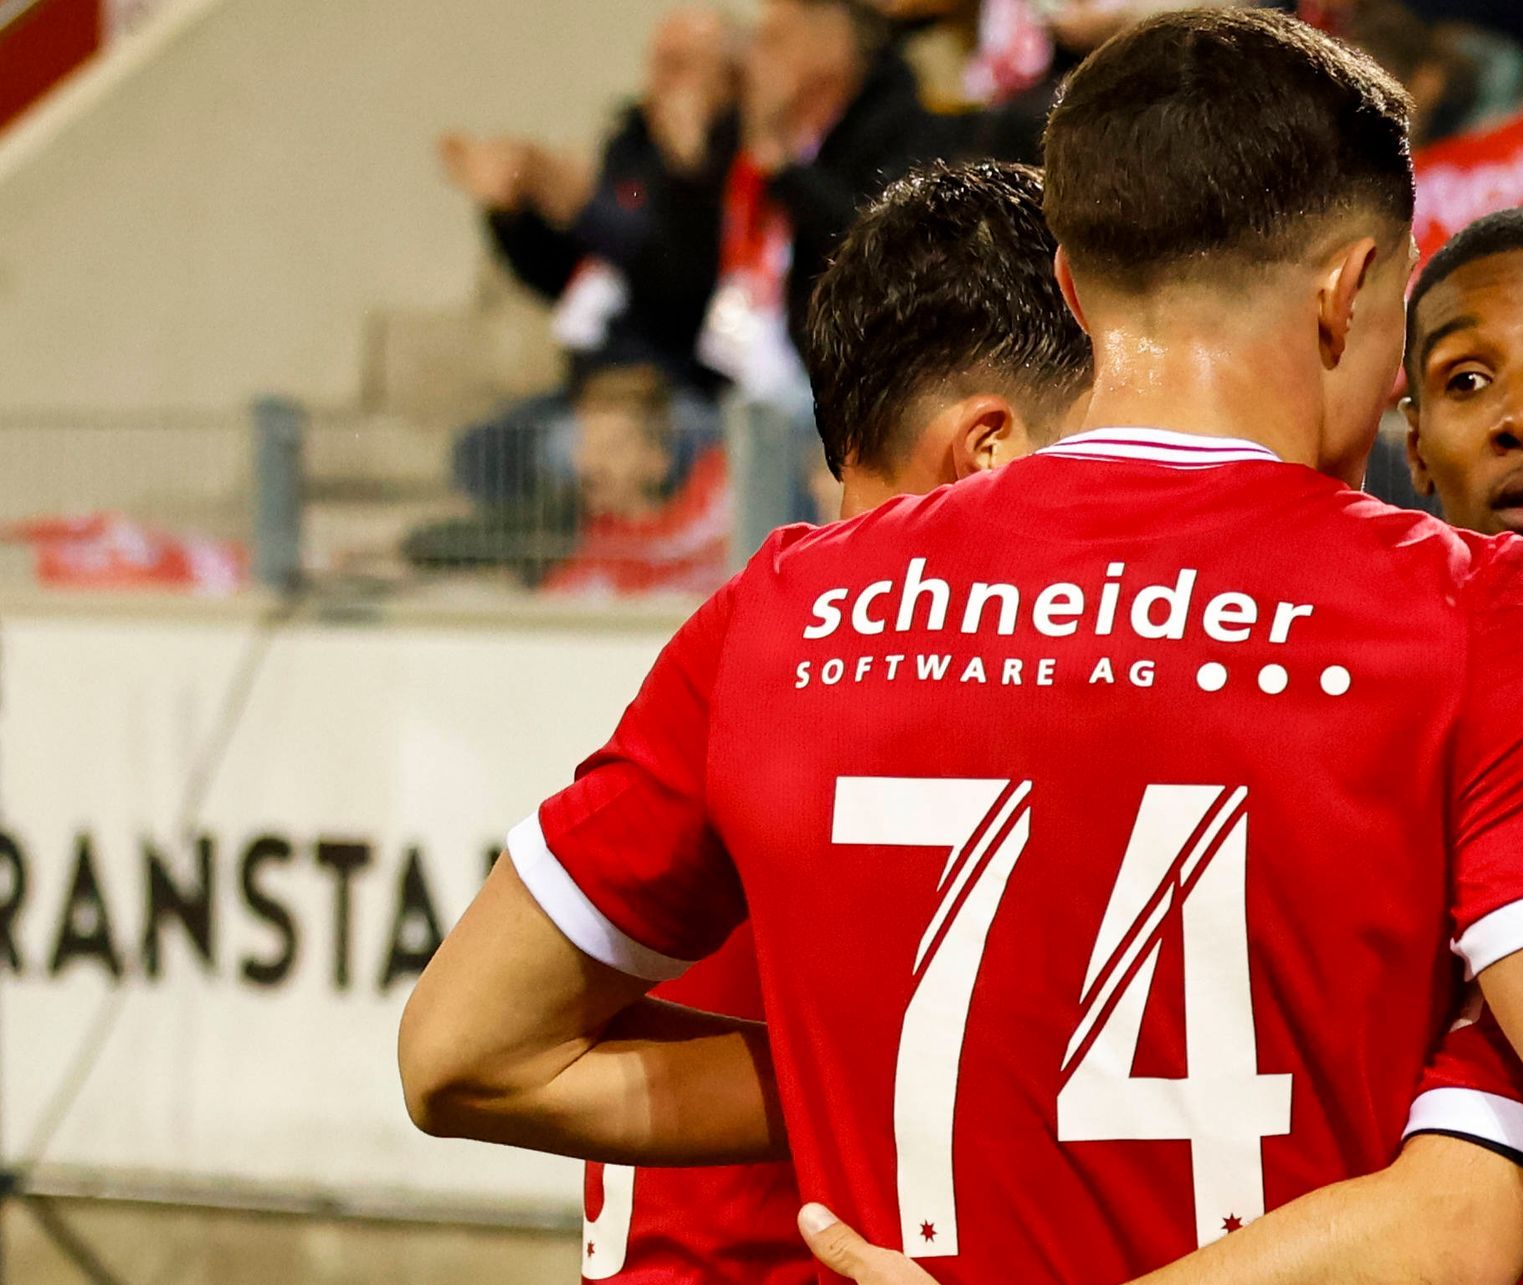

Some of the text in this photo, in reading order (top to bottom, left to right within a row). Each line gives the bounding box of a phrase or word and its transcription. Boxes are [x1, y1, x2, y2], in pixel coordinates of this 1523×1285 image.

[803, 557, 1314, 644] schneider
[795, 654, 1156, 688] SOFTWARE AG
[0, 830, 504, 991] RANSTA
[831, 775, 1293, 1259] 74
